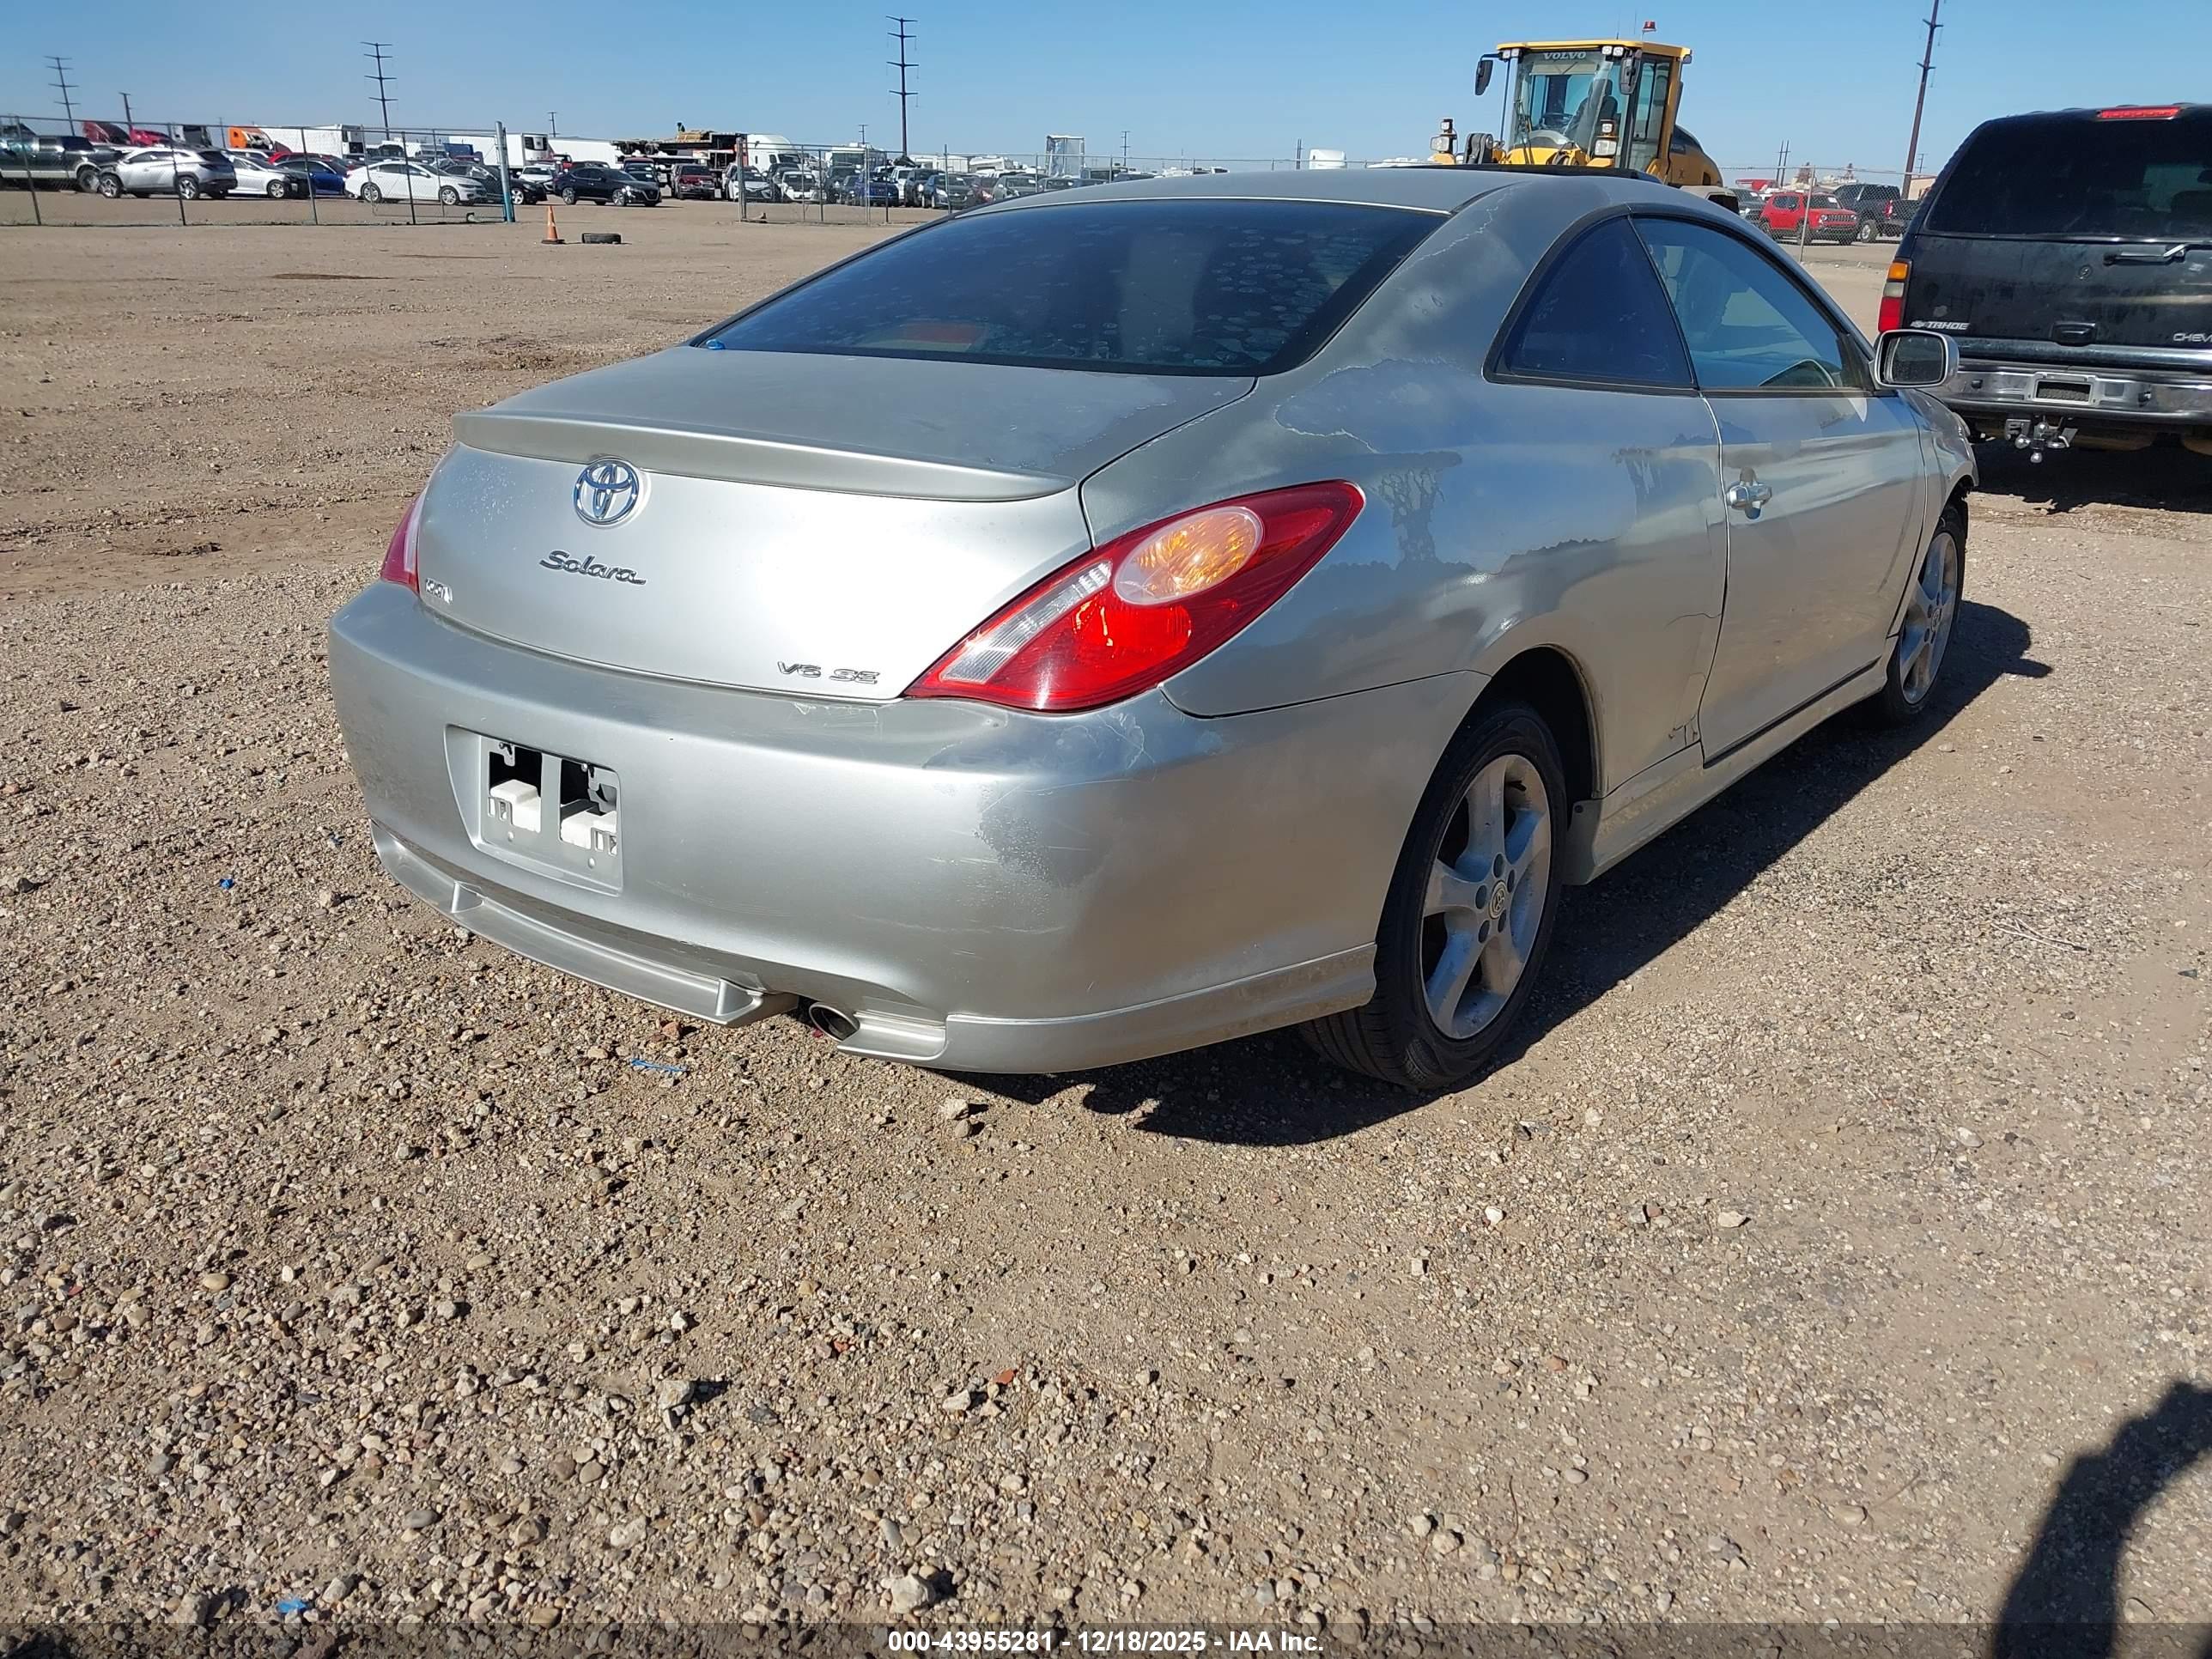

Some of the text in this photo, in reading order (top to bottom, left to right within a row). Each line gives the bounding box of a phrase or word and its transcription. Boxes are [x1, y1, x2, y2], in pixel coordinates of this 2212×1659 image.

[1543, 52, 1586, 60] VOLVO
[1926, 321, 1970, 331] TAHOE
[2173, 333, 2212, 343] CHEV
[538, 550, 647, 586] Solara
[777, 661, 880, 685] V6 SE
